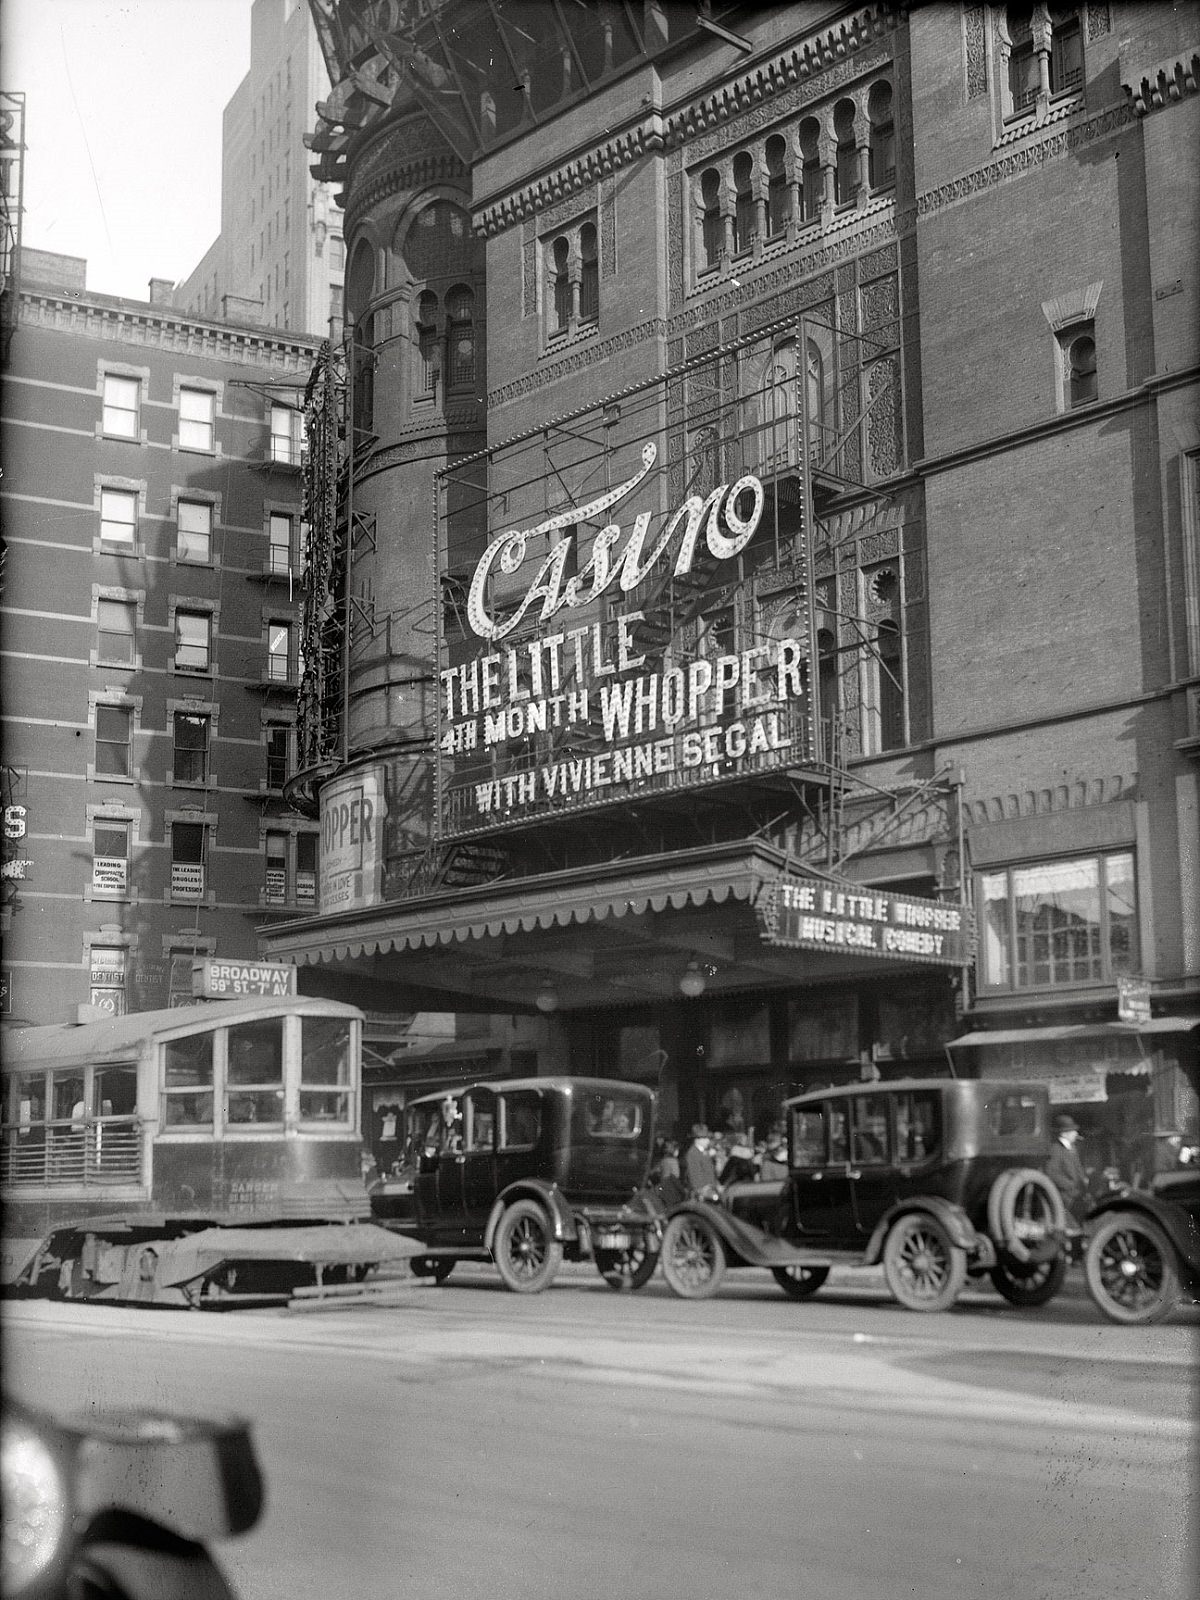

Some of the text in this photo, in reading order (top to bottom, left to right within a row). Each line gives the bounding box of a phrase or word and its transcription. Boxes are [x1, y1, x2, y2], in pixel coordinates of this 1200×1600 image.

[440, 611, 646, 720] THE LITTLE
[600, 638, 803, 742] WHOPPER
[440, 689, 589, 756] 4TH MONTH
[476, 714, 791, 813] WITH VIVIENNE SEGAL
[782, 885, 816, 910] THE
[823, 890, 888, 922] LITTLE
[800, 916, 944, 955] MUSICAL COMEDY
[92, 971, 124, 983] DENTIST
[210, 965, 289, 984] BROADWAY
